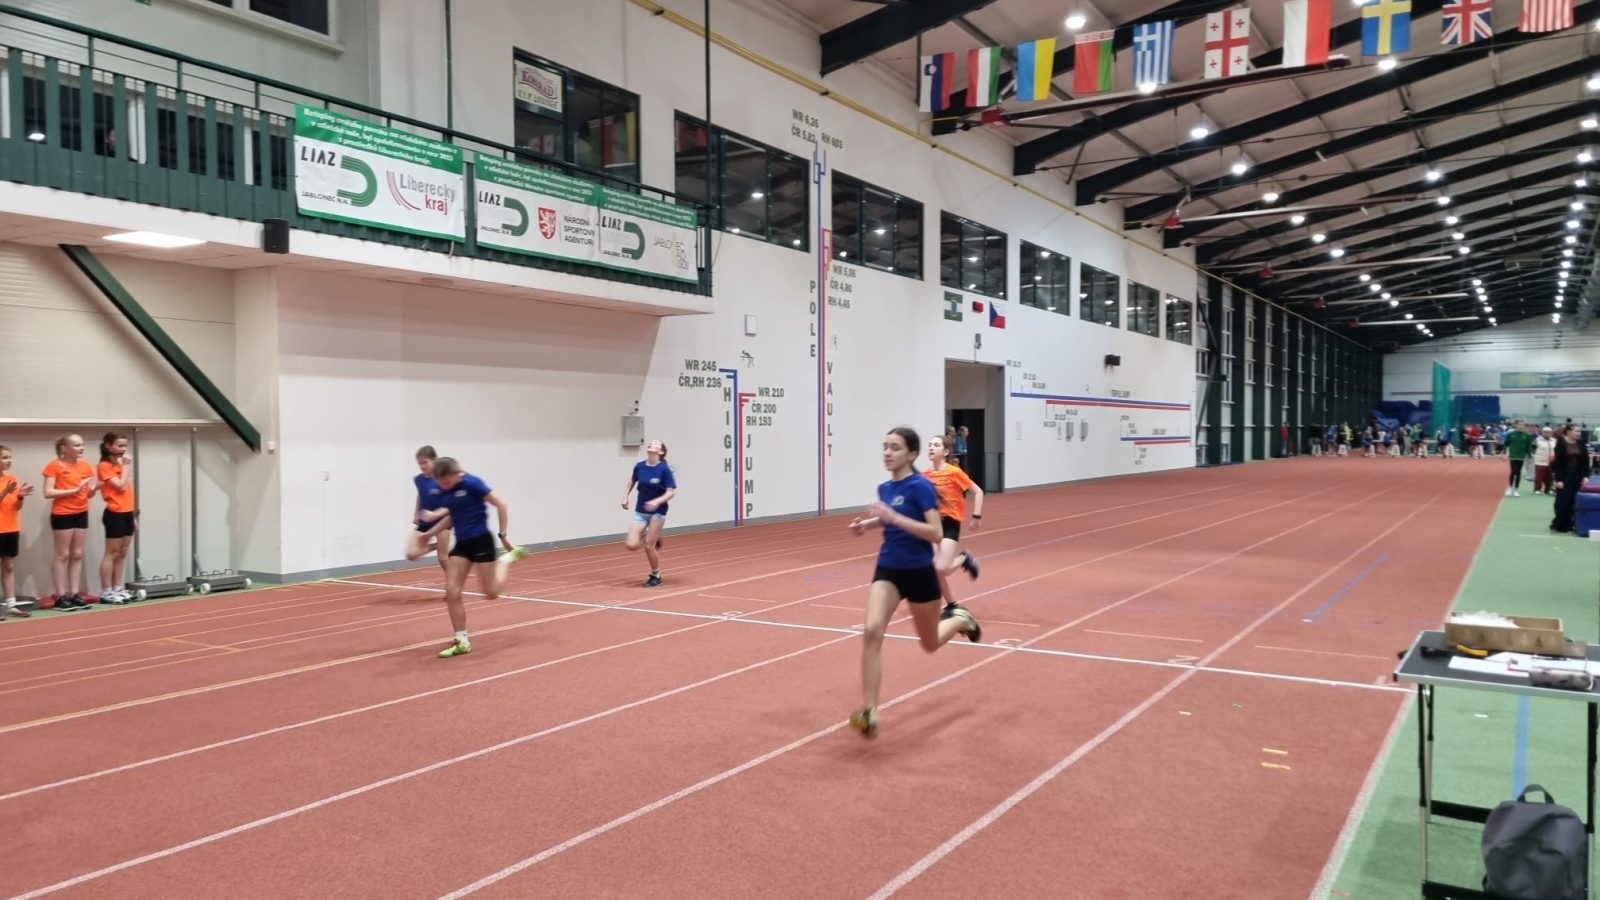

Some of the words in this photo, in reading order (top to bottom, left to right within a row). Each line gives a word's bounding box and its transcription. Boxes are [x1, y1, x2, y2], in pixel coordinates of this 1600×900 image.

[301, 146, 336, 167] LIAZ
[400, 173, 456, 203] Liberecký
[425, 195, 448, 215] kraj
[479, 191, 501, 206] LIAZ
[602, 216, 622, 231] LIAZ
[809, 280, 817, 357] POLE
[685, 359, 699, 371] WR
[701, 361, 717, 372] 245
[706, 377, 722, 388] 236
[758, 387, 771, 397] WR
[772, 388, 784, 398] 210
[752, 400, 762, 413] ČR
[763, 404, 777, 413] 200
[826, 361, 834, 456] VAULT
[723, 387, 732, 472] HIGH
[746, 416, 757, 426] RH
[759, 416, 772, 426] 193
[744, 434, 754, 517] JUMP
